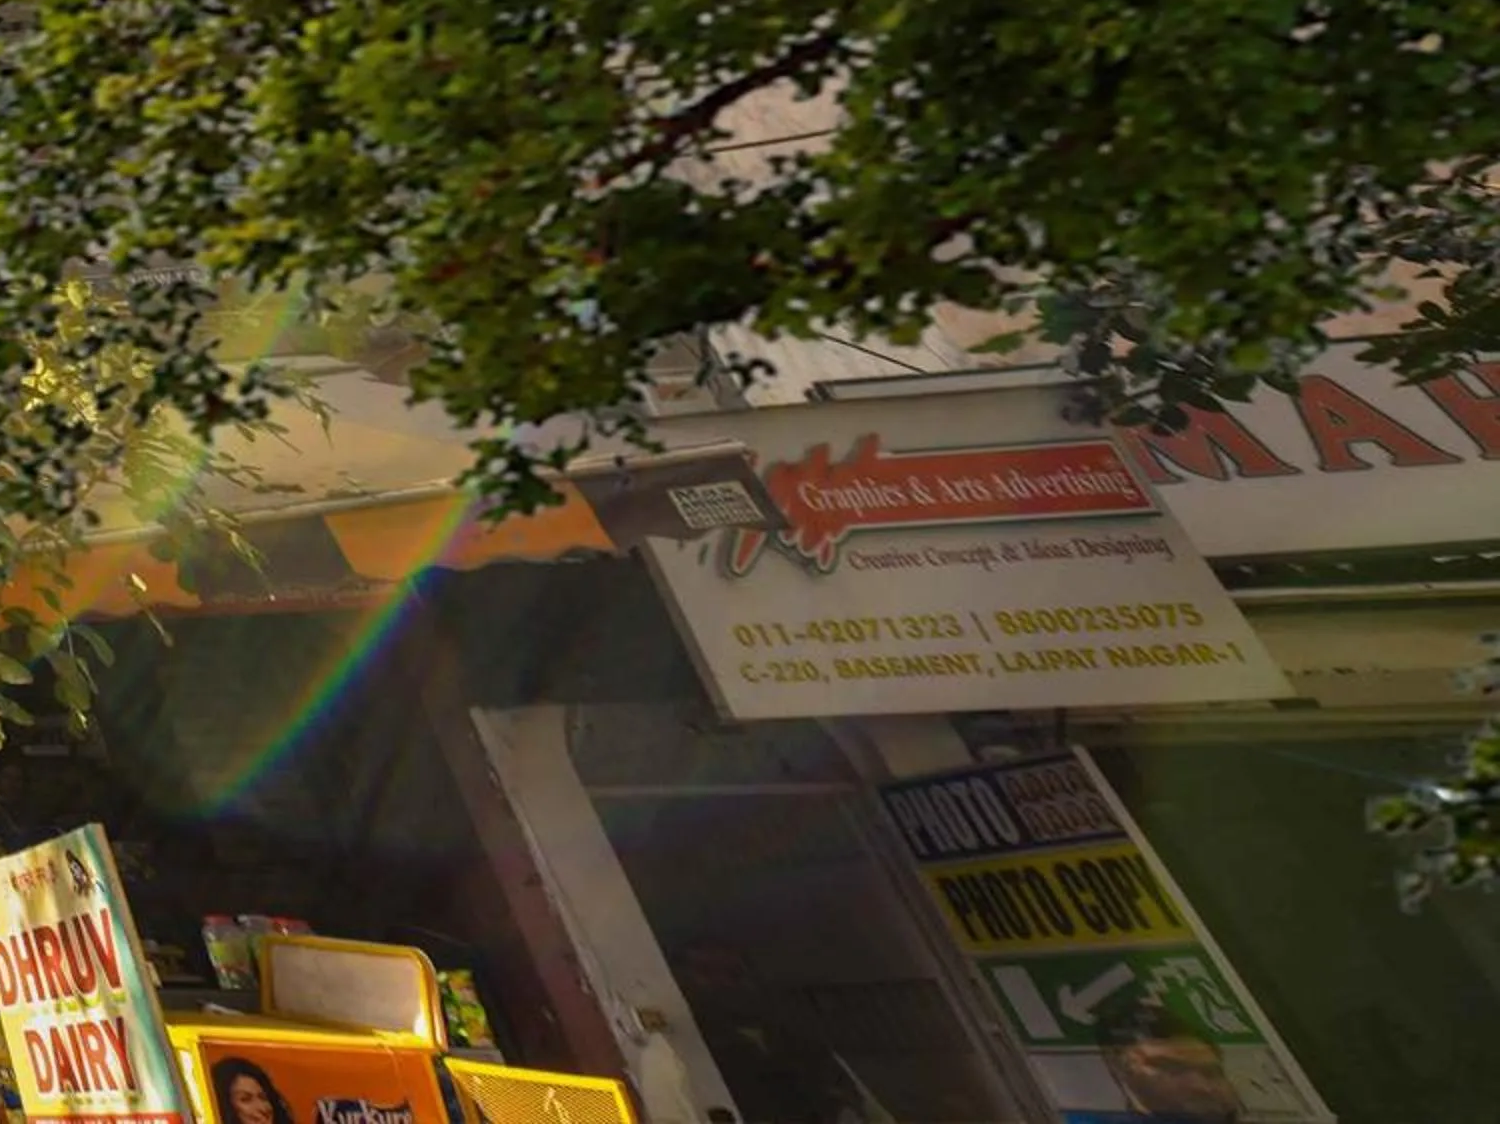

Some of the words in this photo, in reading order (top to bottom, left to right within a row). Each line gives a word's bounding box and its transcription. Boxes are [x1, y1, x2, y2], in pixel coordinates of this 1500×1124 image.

[797, 476, 909, 518] Graphics
[907, 474, 937, 507] &
[934, 473, 992, 505] Arts
[990, 463, 1140, 502] Advertising
[850, 549, 924, 571] Creative
[1069, 532, 1175, 565] Designing
[733, 612, 965, 648] 011-42071323
[994, 602, 1205, 637] 8800235075
[995, 648, 1099, 674] LAJPAT
[1102, 641, 1247, 669] NAGAR-1
[886, 776, 1021, 856] PHOTO
[936, 865, 1077, 943] PHOTO
[1052, 851, 1185, 936] COPY
[23, 1015, 137, 1094] DAIRY
